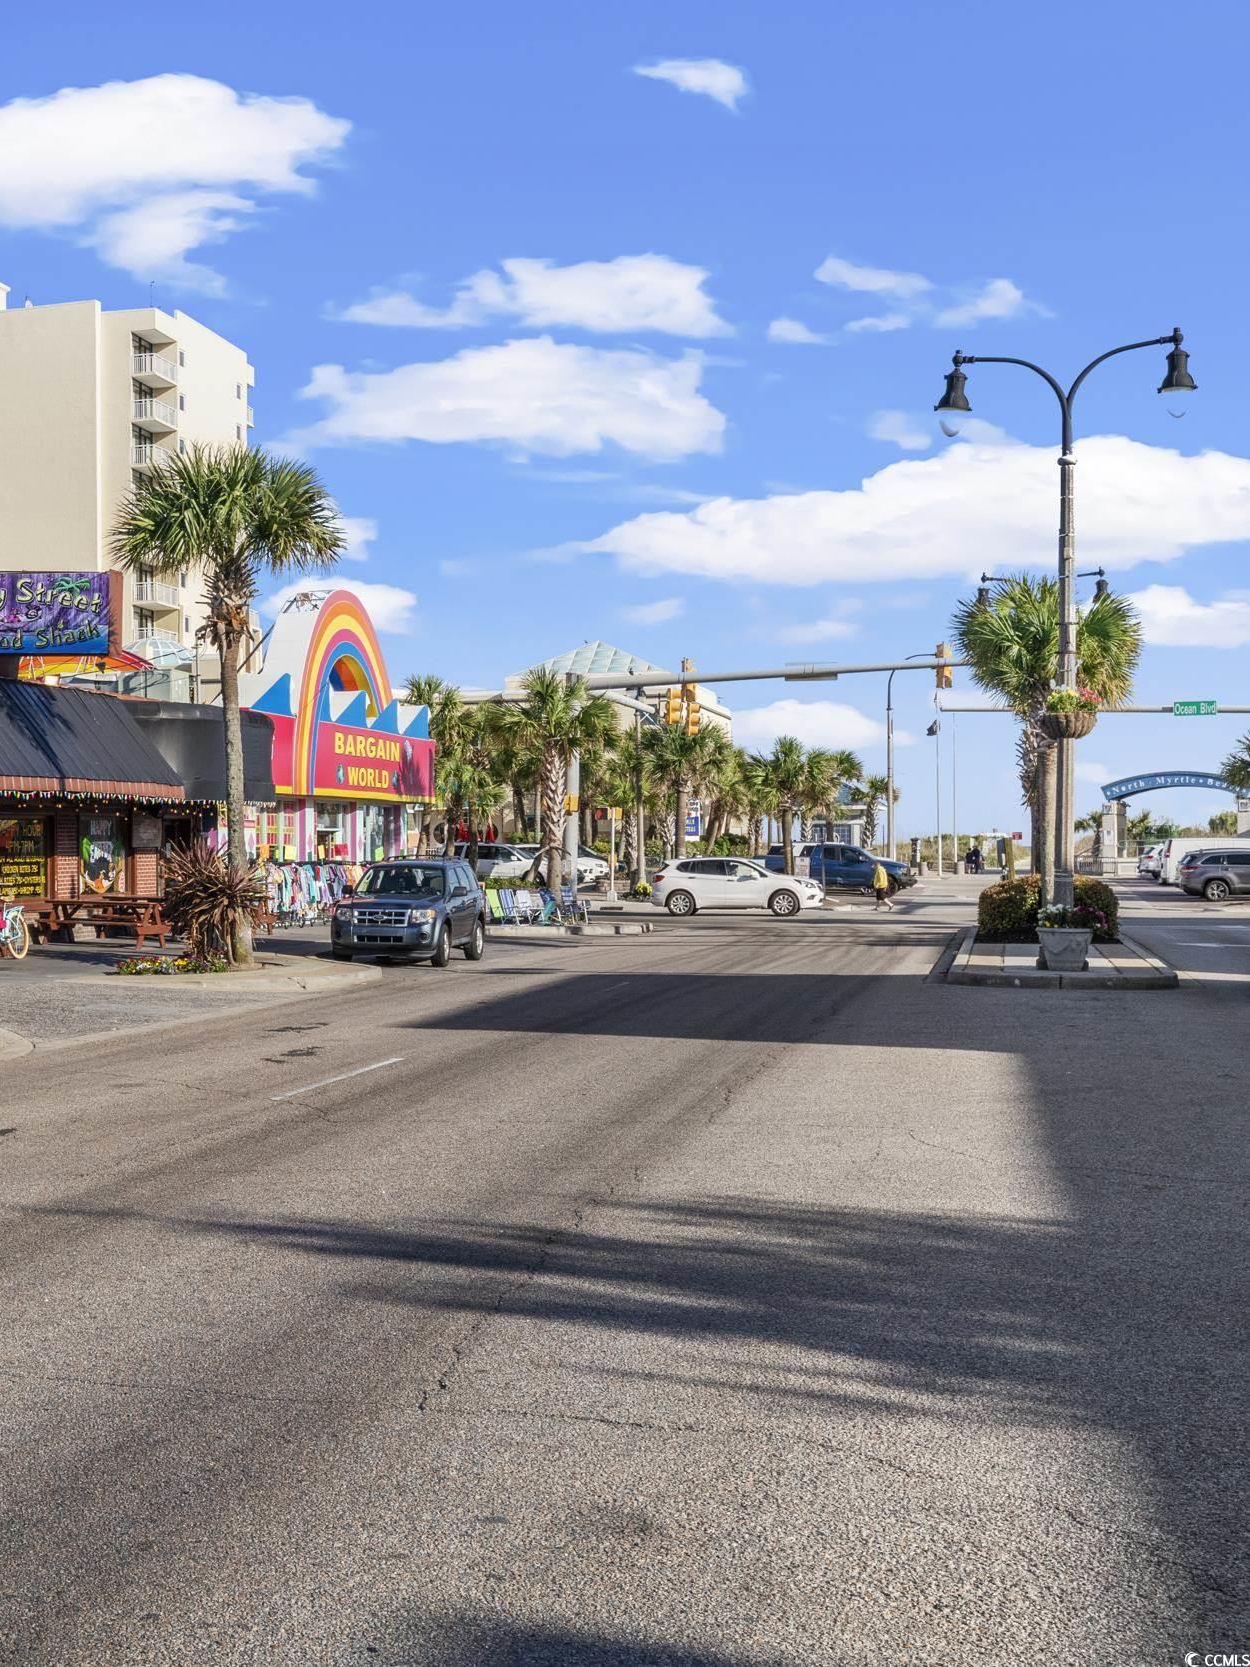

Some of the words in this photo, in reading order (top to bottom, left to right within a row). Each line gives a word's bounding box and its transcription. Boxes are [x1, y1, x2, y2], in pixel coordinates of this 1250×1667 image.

[15, 577, 104, 614] Street
[34, 618, 100, 648] Shack
[1174, 703, 1197, 714] Ocean
[1200, 702, 1216, 714] Blvd
[333, 731, 400, 762] BARGAIN
[347, 766, 389, 789] WORLD
[1112, 780, 1145, 795] North
[1156, 776, 1196, 786] Myrtle
